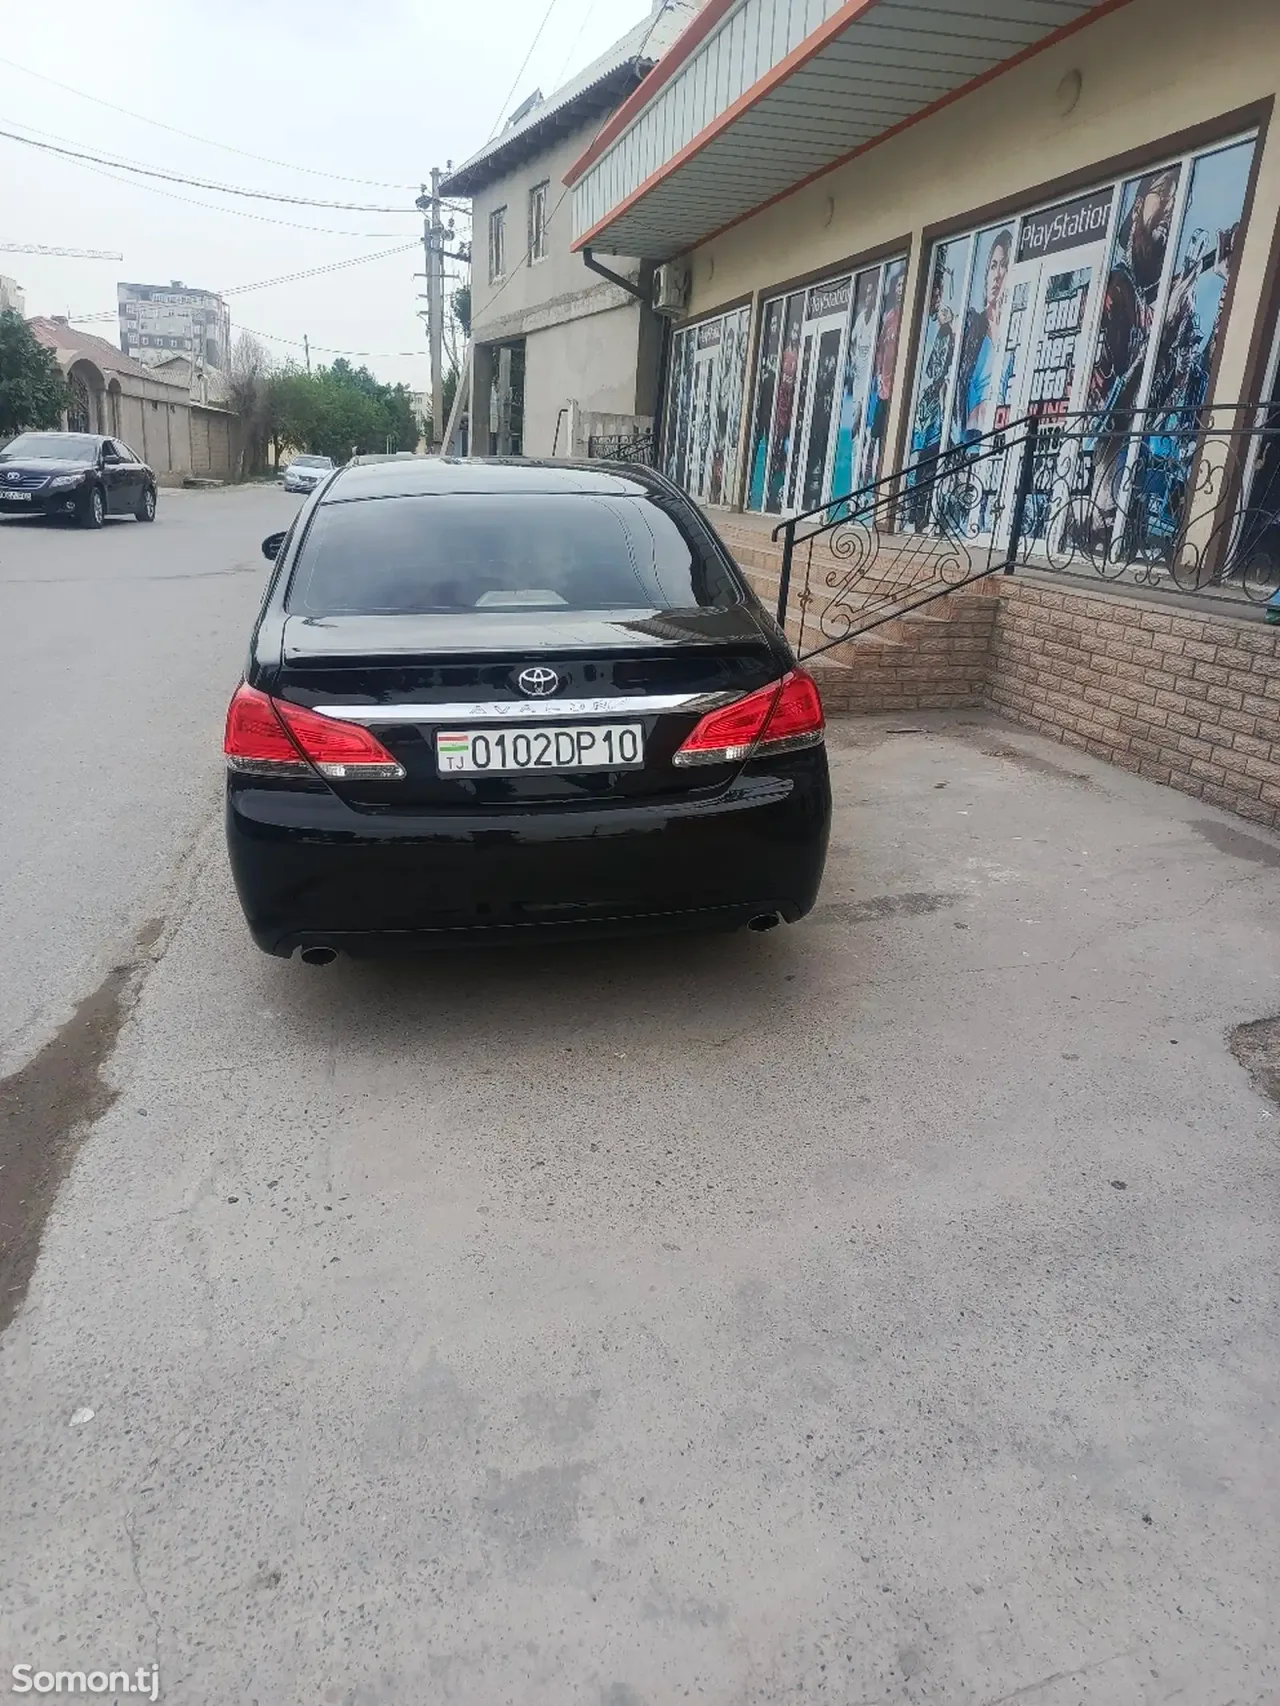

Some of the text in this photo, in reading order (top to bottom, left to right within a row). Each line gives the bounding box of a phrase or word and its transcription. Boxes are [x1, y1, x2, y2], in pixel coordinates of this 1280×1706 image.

[1020, 203, 1112, 251] PlayStation
[446, 756, 464, 770] TJ
[471, 729, 638, 769] 0102DP10
